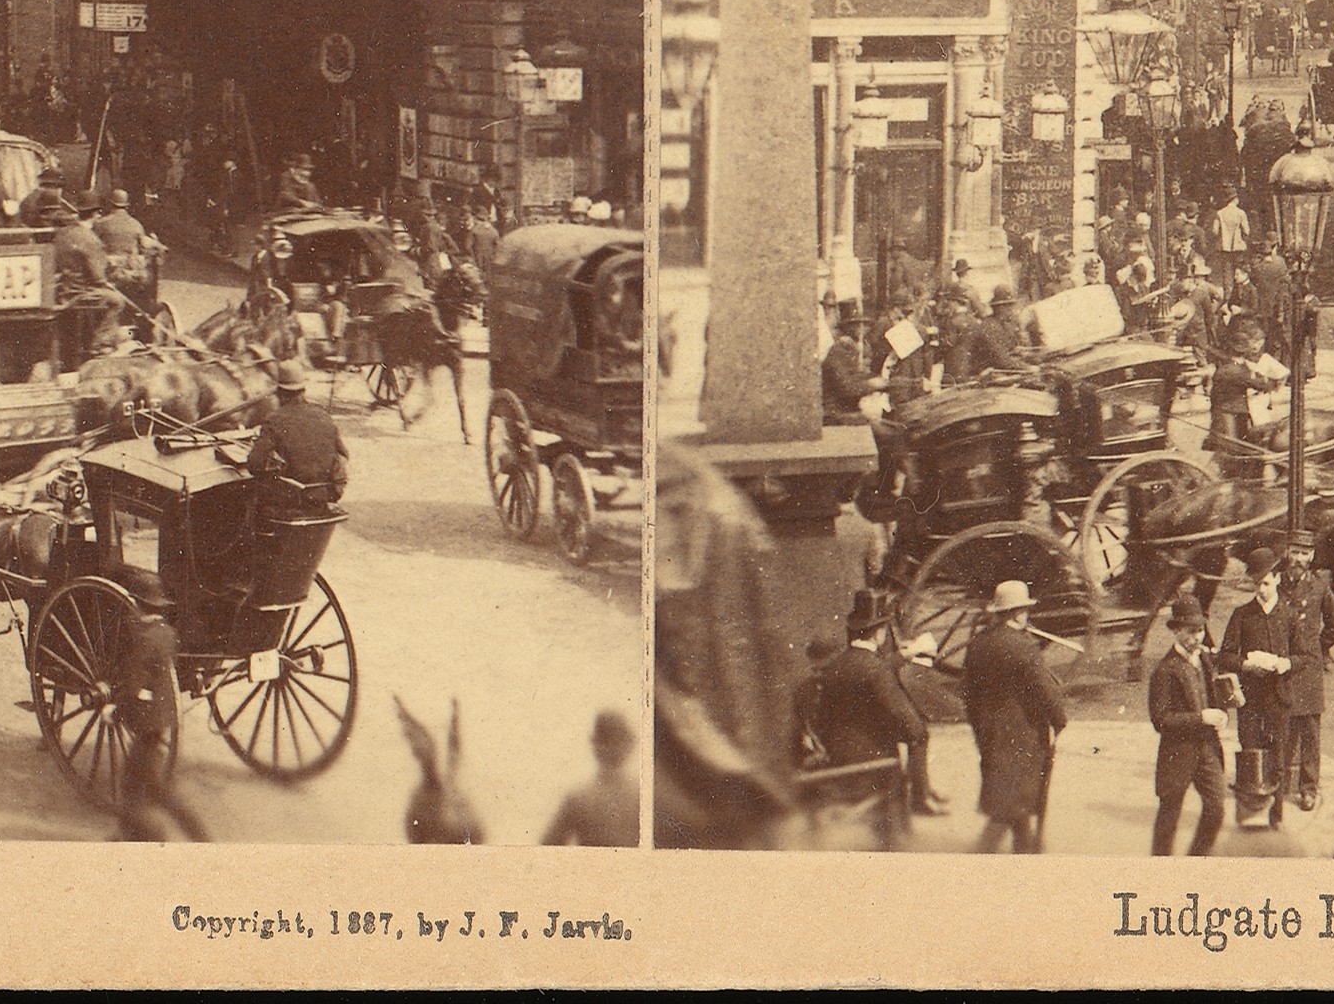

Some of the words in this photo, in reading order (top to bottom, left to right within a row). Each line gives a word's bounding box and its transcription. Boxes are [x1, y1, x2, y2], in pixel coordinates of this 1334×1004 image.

[1017, 28, 1072, 45] KING
[171, 904, 314, 939] Copyright,
[329, 910, 403, 940] 1887,
[417, 910, 450, 942] by
[458, 910, 486, 938] J.
[499, 910, 529, 939] F.
[542, 910, 633, 941] Jarvis.
[1113, 891, 1303, 953] Ludgate
